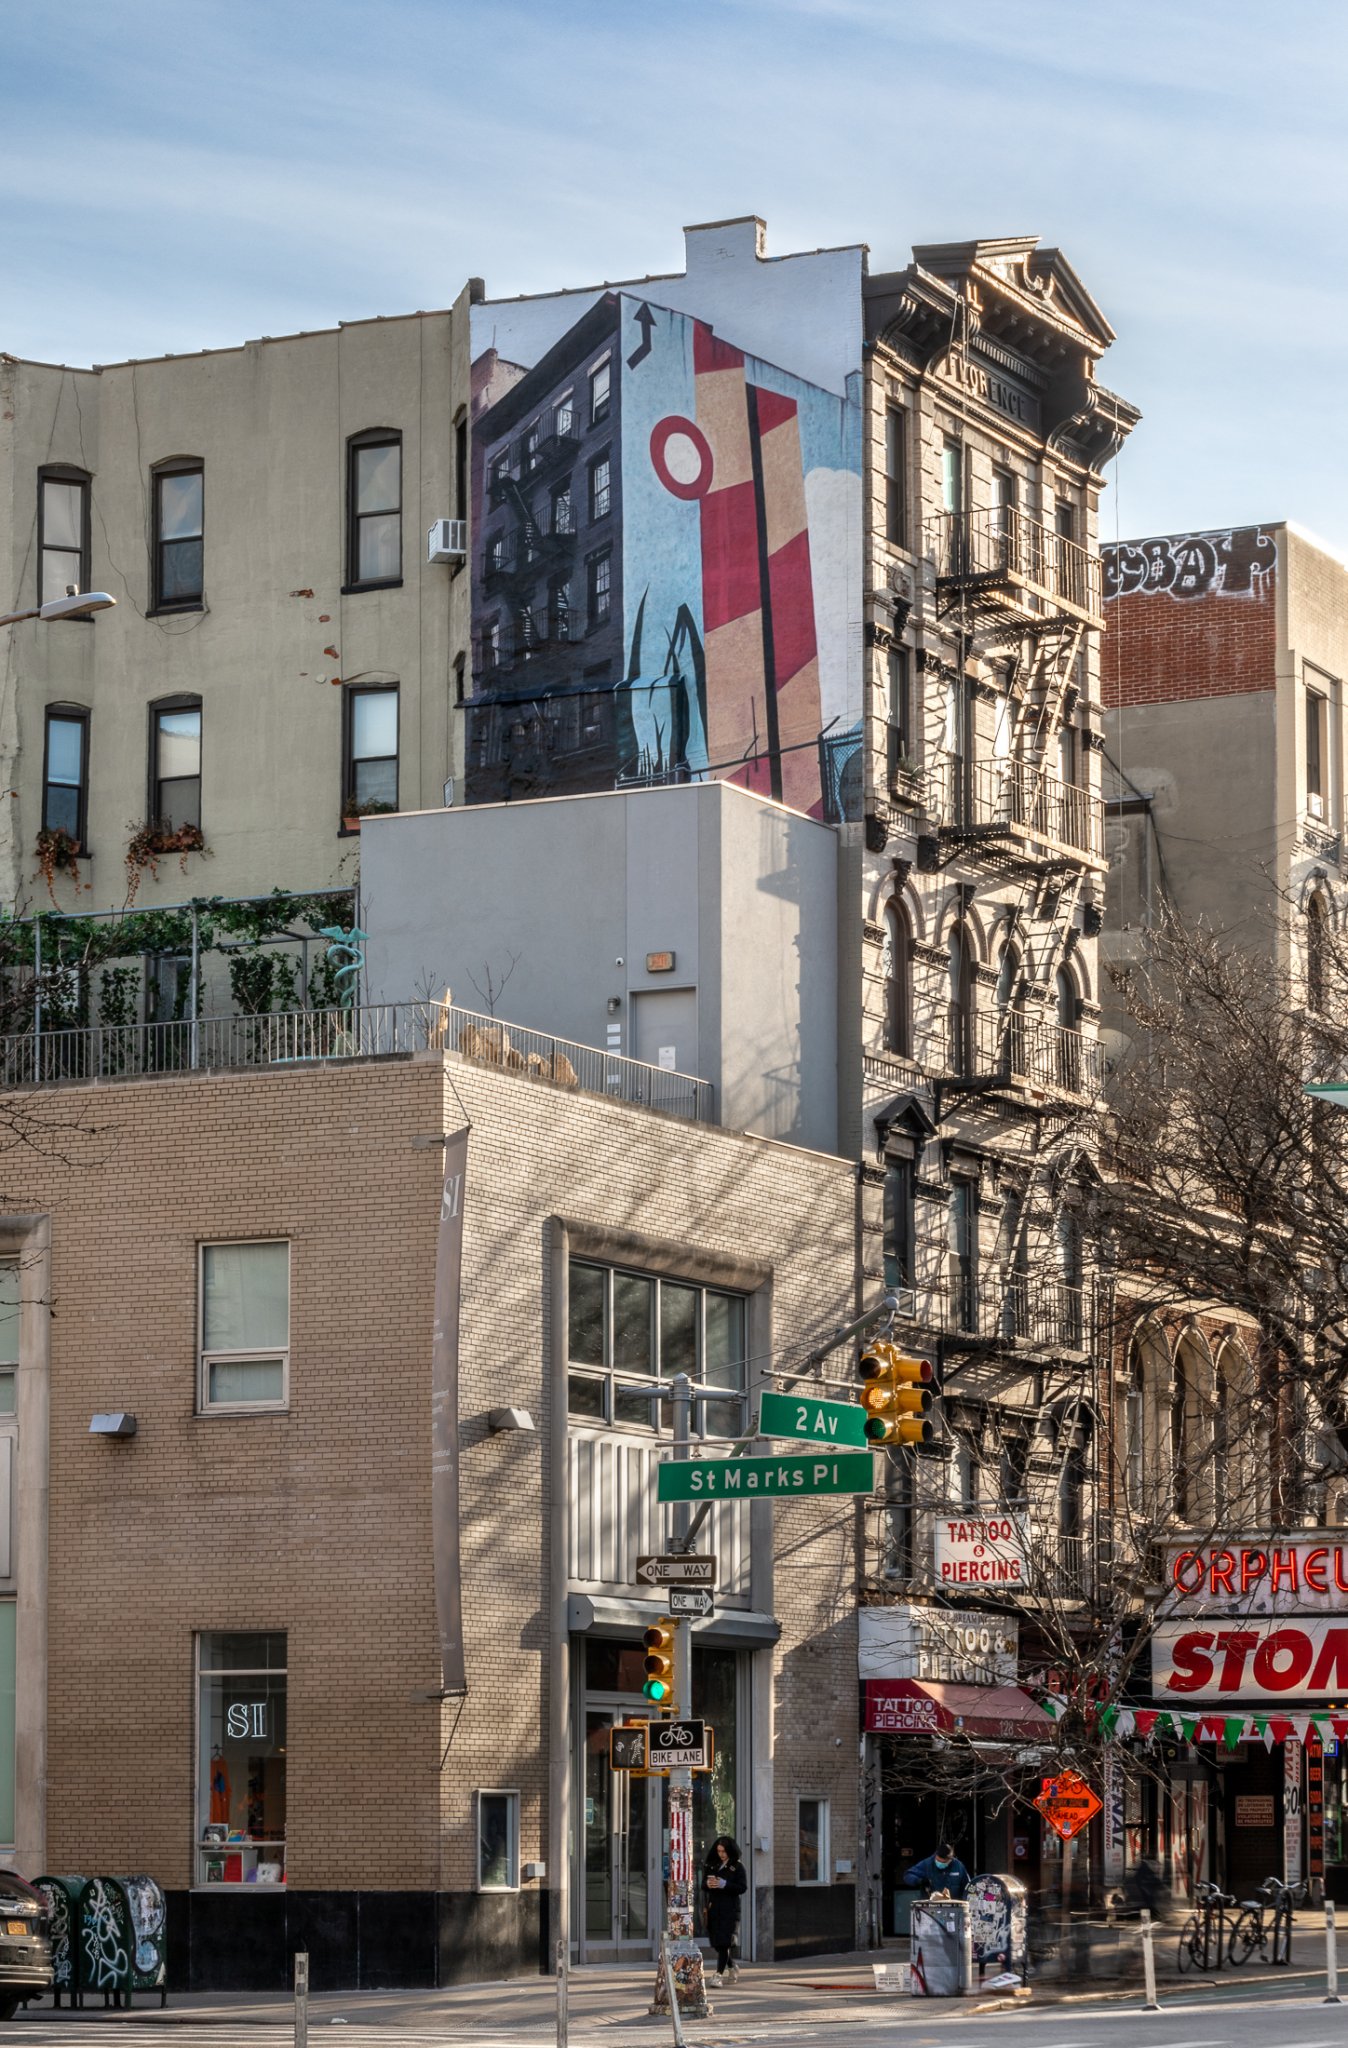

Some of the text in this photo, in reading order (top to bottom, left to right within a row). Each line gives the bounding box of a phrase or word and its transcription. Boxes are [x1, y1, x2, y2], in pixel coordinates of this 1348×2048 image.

[440, 1174, 463, 1222] SI
[795, 1406, 838, 1436] 2 Av
[690, 1464, 838, 1491] St Marks Pl
[947, 1520, 1012, 1543] TATTOO
[646, 1564, 709, 1577] ONE WAY
[941, 1559, 1021, 1583] PIERCING
[672, 1595, 709, 1608] ONE WAY
[920, 1625, 991, 1653] TATTOO
[873, 1698, 935, 1713] TATTOO
[227, 1703, 268, 1738] SI
[873, 1714, 937, 1728] PIERCING
[1000, 1720, 1014, 1736] 128
[652, 1750, 702, 1763] BIKE LANE
[1057, 1812, 1078, 1820] AHEAD
